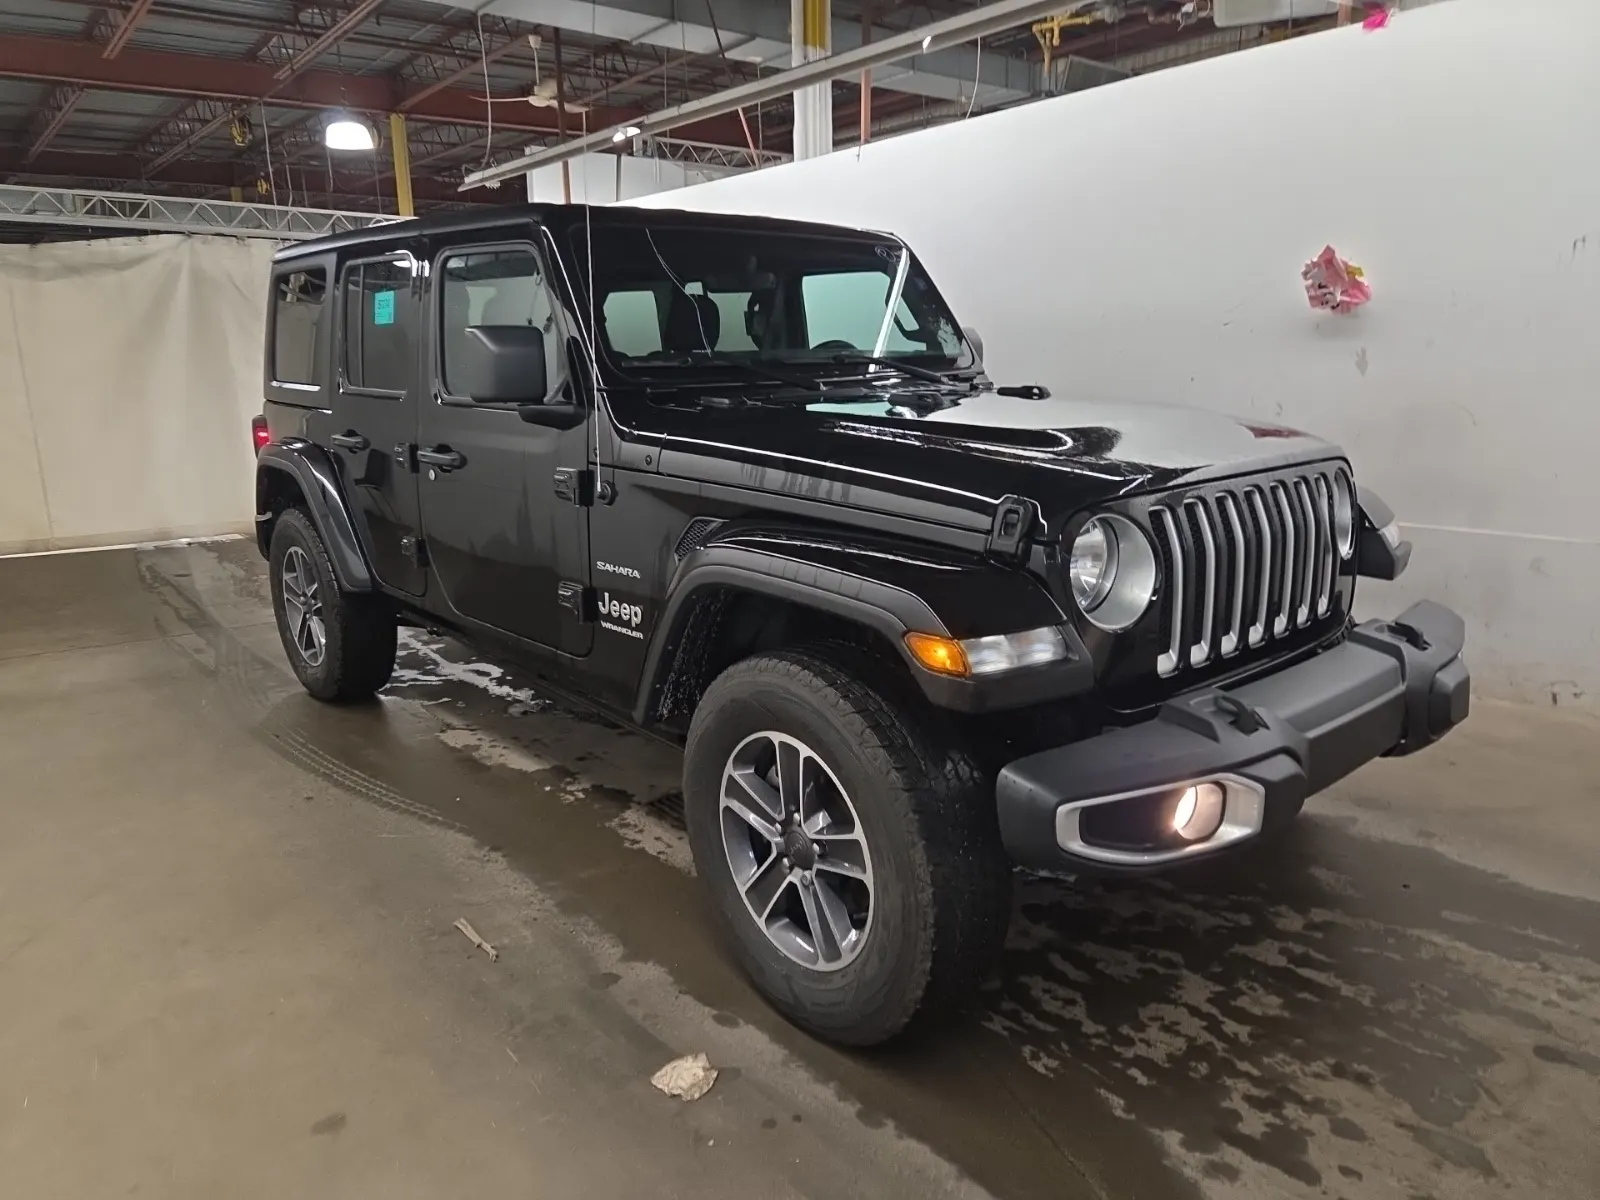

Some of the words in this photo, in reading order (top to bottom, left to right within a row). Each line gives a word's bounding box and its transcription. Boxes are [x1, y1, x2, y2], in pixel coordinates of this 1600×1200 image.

[596, 560, 641, 579] SAHARA
[597, 591, 642, 628] Jeep
[600, 620, 644, 640] WRANGLER
